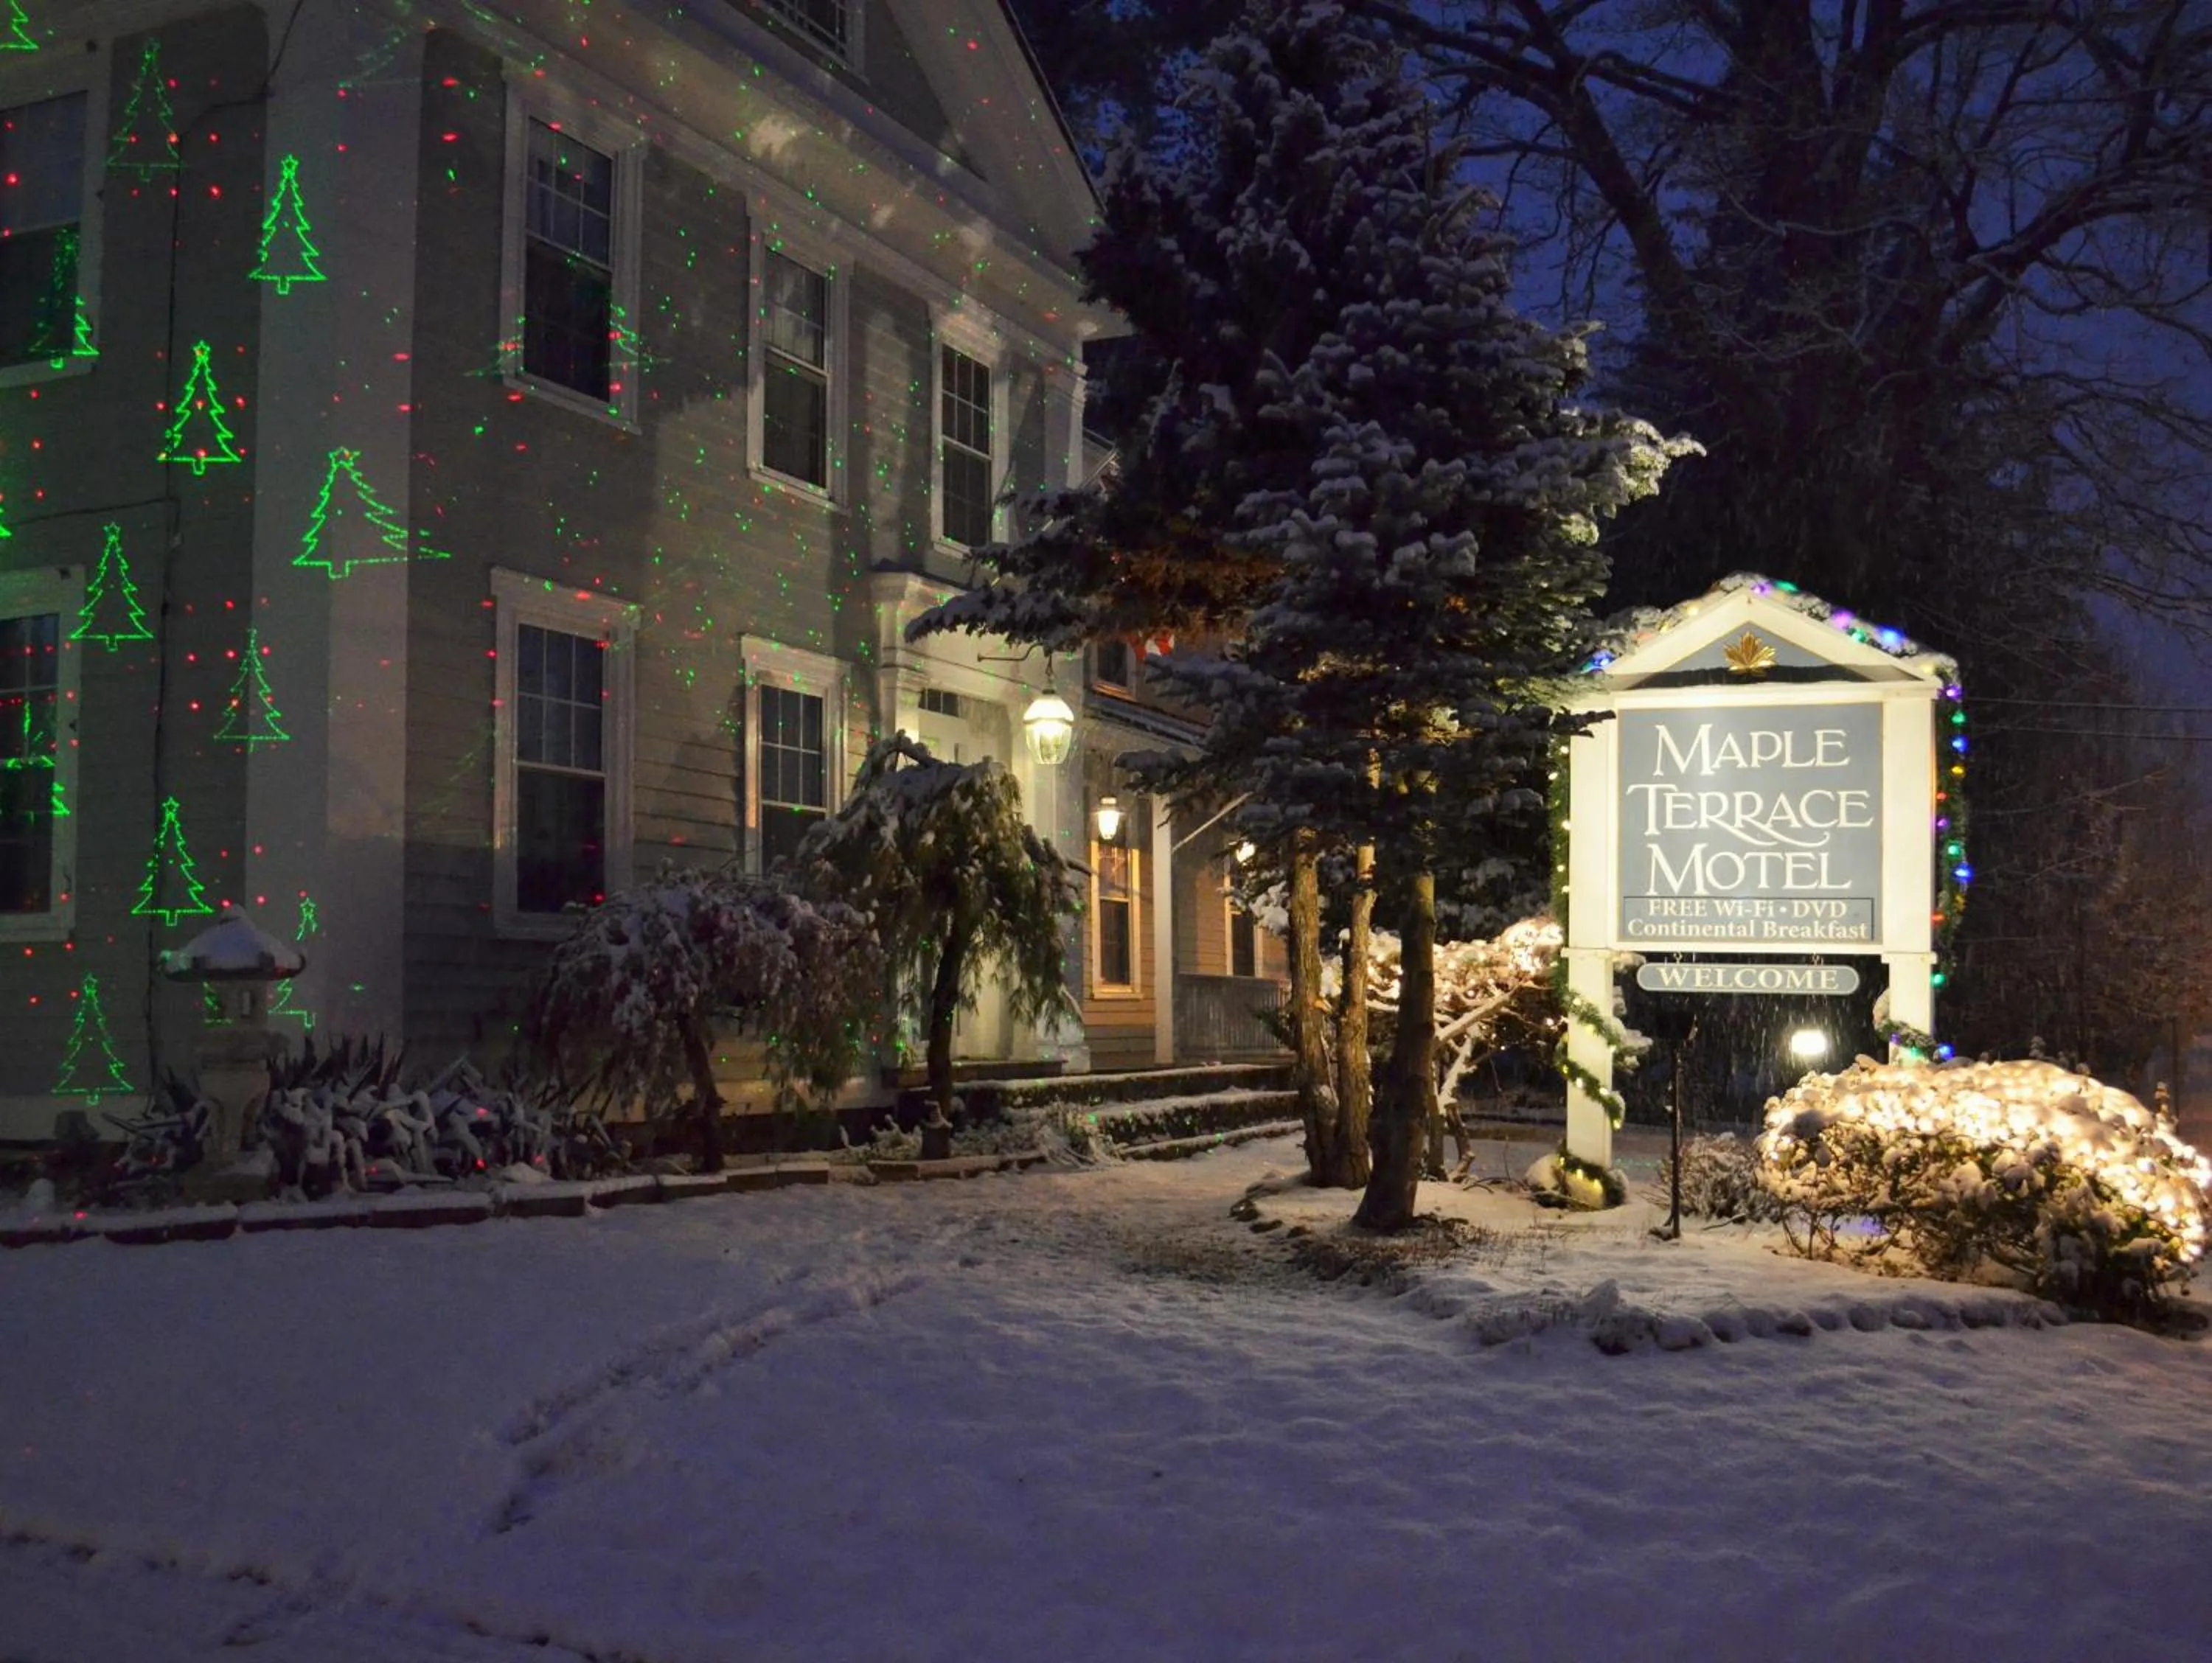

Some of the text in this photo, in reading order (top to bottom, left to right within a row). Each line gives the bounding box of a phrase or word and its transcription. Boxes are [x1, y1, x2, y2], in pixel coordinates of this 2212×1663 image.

[1653, 724, 1850, 776] MAPLE
[1626, 784, 1874, 847] TERRACE
[1645, 843, 1852, 896] MOTEL
[1649, 899, 1847, 918] FREE Wi-Fi DVD
[1628, 919, 1867, 939] Continental Breakfast
[1657, 967, 1839, 990] WELCOME
